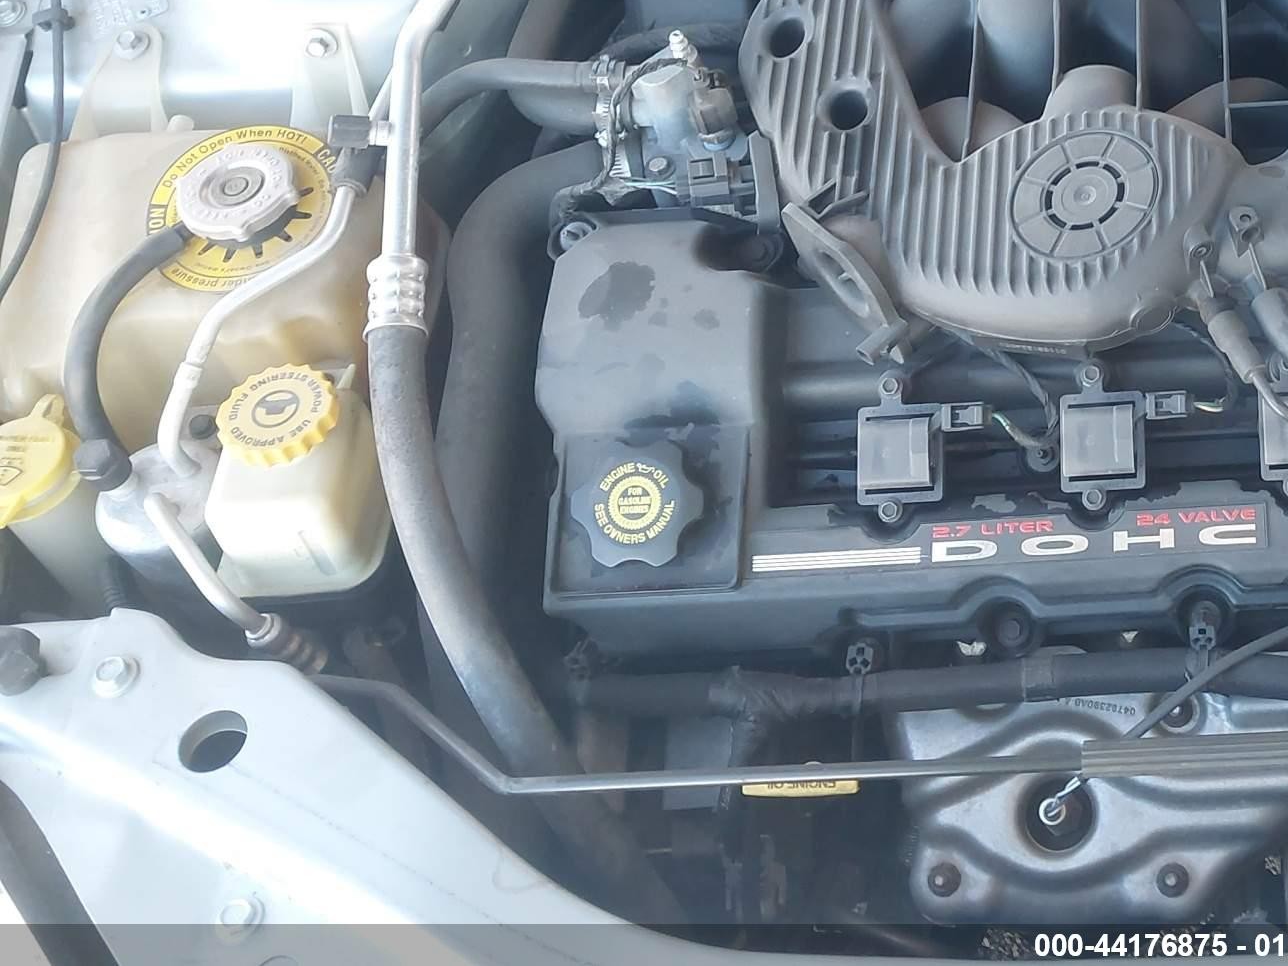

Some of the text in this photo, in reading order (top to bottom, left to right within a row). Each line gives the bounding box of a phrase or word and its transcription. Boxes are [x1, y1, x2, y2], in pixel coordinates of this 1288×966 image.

[162, 128, 308, 189] Do Not Open When HOT!
[171, 268, 217, 287] pressure
[250, 372, 308, 391] STEERING
[229, 393, 249, 421] FLUID
[230, 419, 311, 447] USE APPROVED
[600, 462, 669, 491] ENGINE OIL
[627, 487, 642, 495] FOR
[594, 500, 675, 544] SEE OWNERS MANUAL
[932, 520, 1055, 538] 2.7 LITER
[1136, 508, 1257, 527] 24 VALVE
[932, 523, 1257, 563] DOHC
